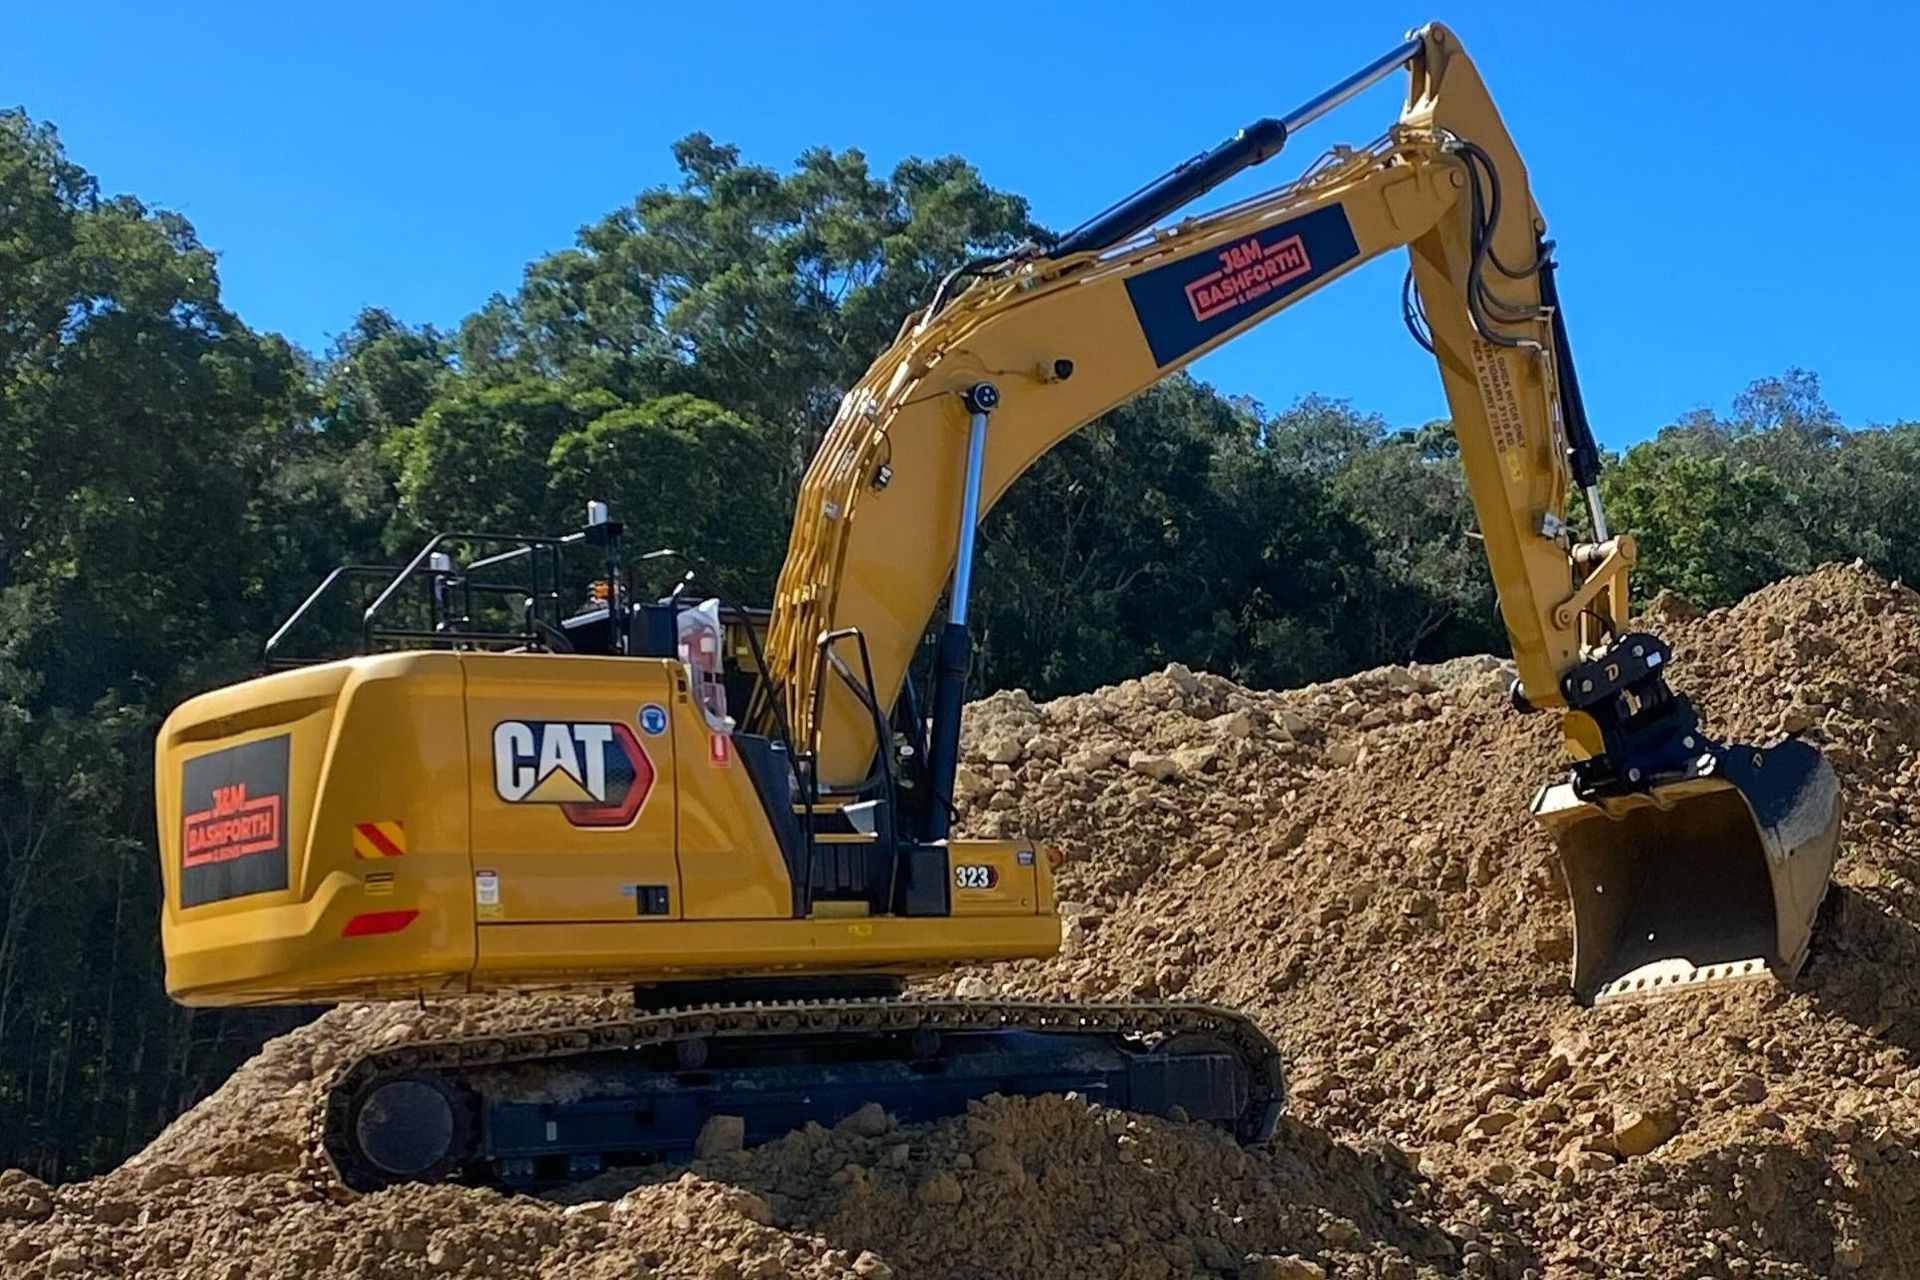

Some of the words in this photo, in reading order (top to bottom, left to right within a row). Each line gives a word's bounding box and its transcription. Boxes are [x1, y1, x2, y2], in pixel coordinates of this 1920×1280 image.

[1219, 239, 1262, 274] J&M
[1197, 248, 1300, 308] BASHFORTH
[1482, 342, 1504, 402] STATIONARY
[1480, 376, 1496, 410] CARRY
[1513, 423, 1527, 448] ONLY
[494, 721, 613, 802] CAT
[212, 783, 247, 817] J&M
[188, 811, 272, 852] BASHFORTH
[956, 866, 988, 887] 323
